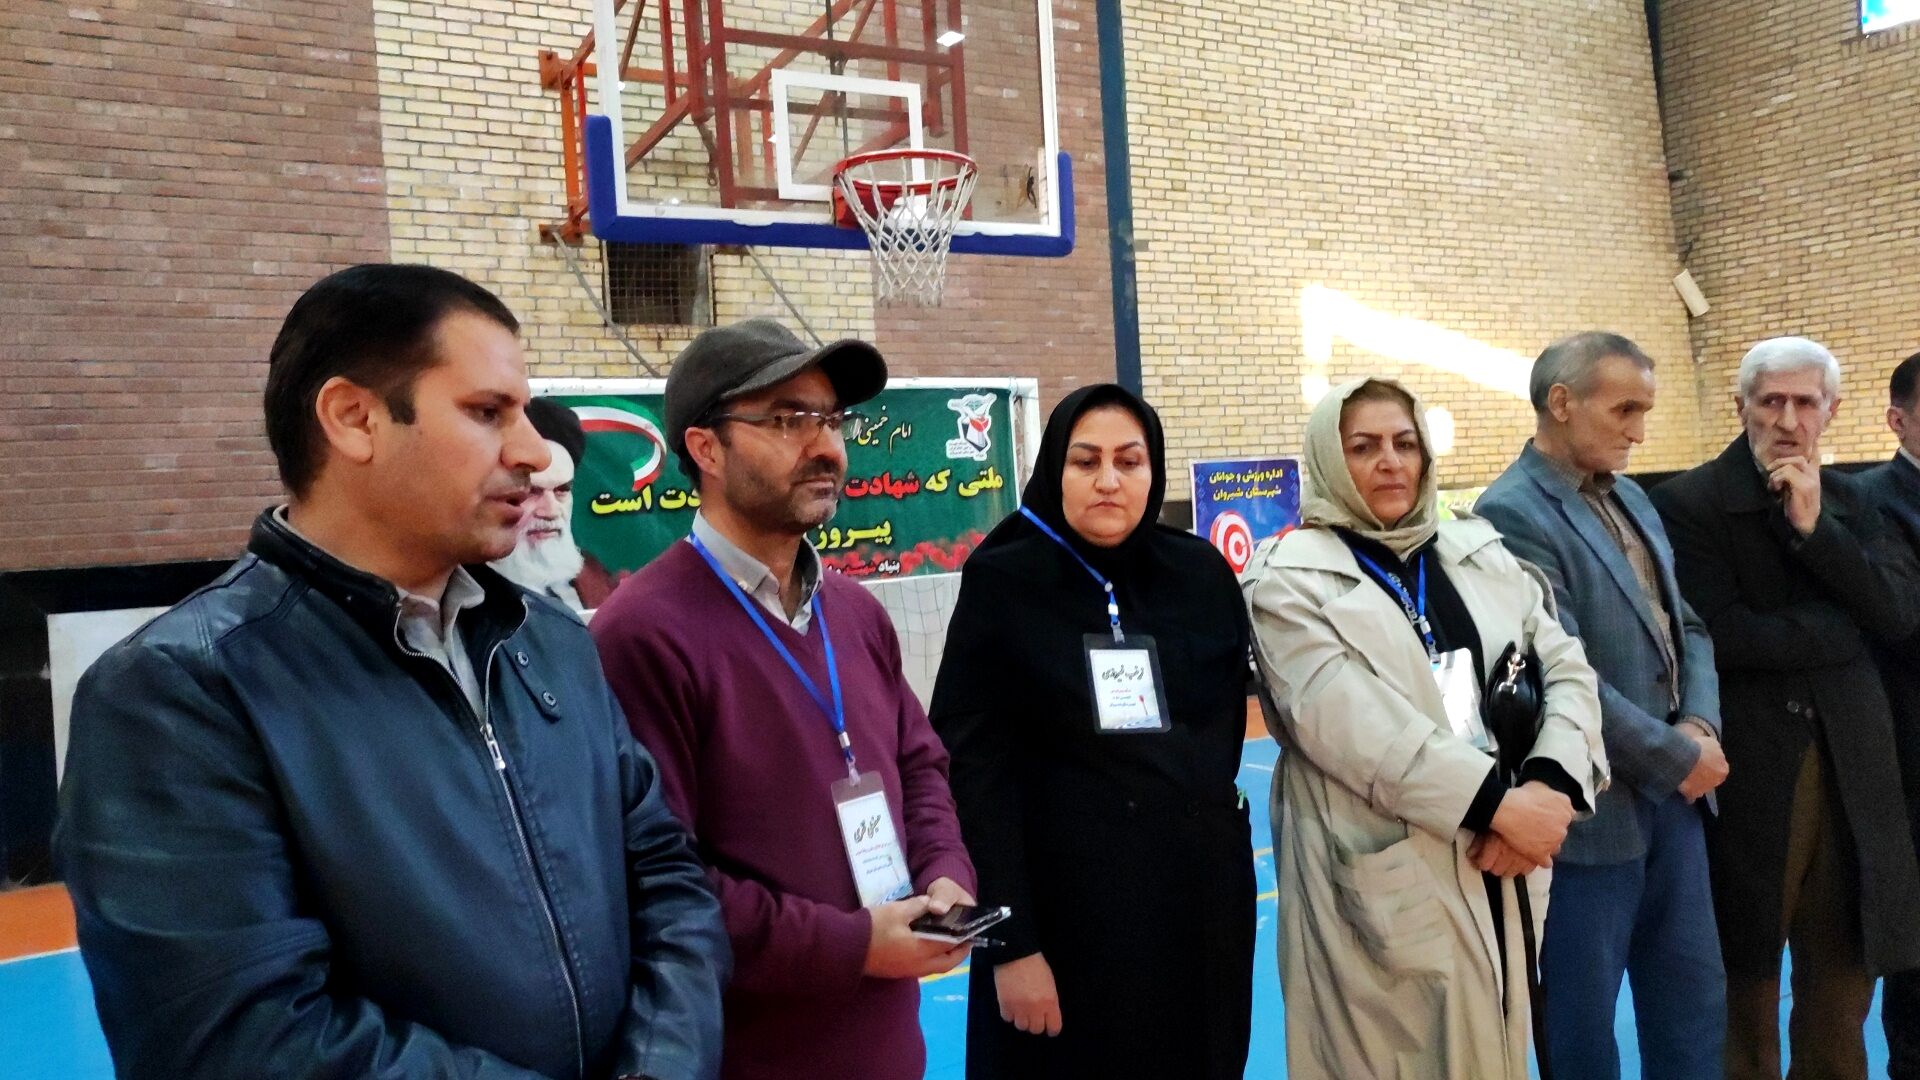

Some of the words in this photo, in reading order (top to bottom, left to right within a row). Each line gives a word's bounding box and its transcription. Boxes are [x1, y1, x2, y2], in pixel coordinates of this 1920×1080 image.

[857, 404, 889, 446] خمینی
[888, 421, 912, 455] امام
[844, 471, 920, 499] شهادت
[924, 468, 951, 493] که
[957, 465, 1004, 498] ملتی
[1209, 471, 1235, 484] جوانان
[1241, 468, 1265, 484] ورزش
[1265, 468, 1283, 482] اداره
[591, 484, 653, 515] است
[1245, 484, 1282, 499] شهرستان
[814, 520, 893, 550] پیروز
